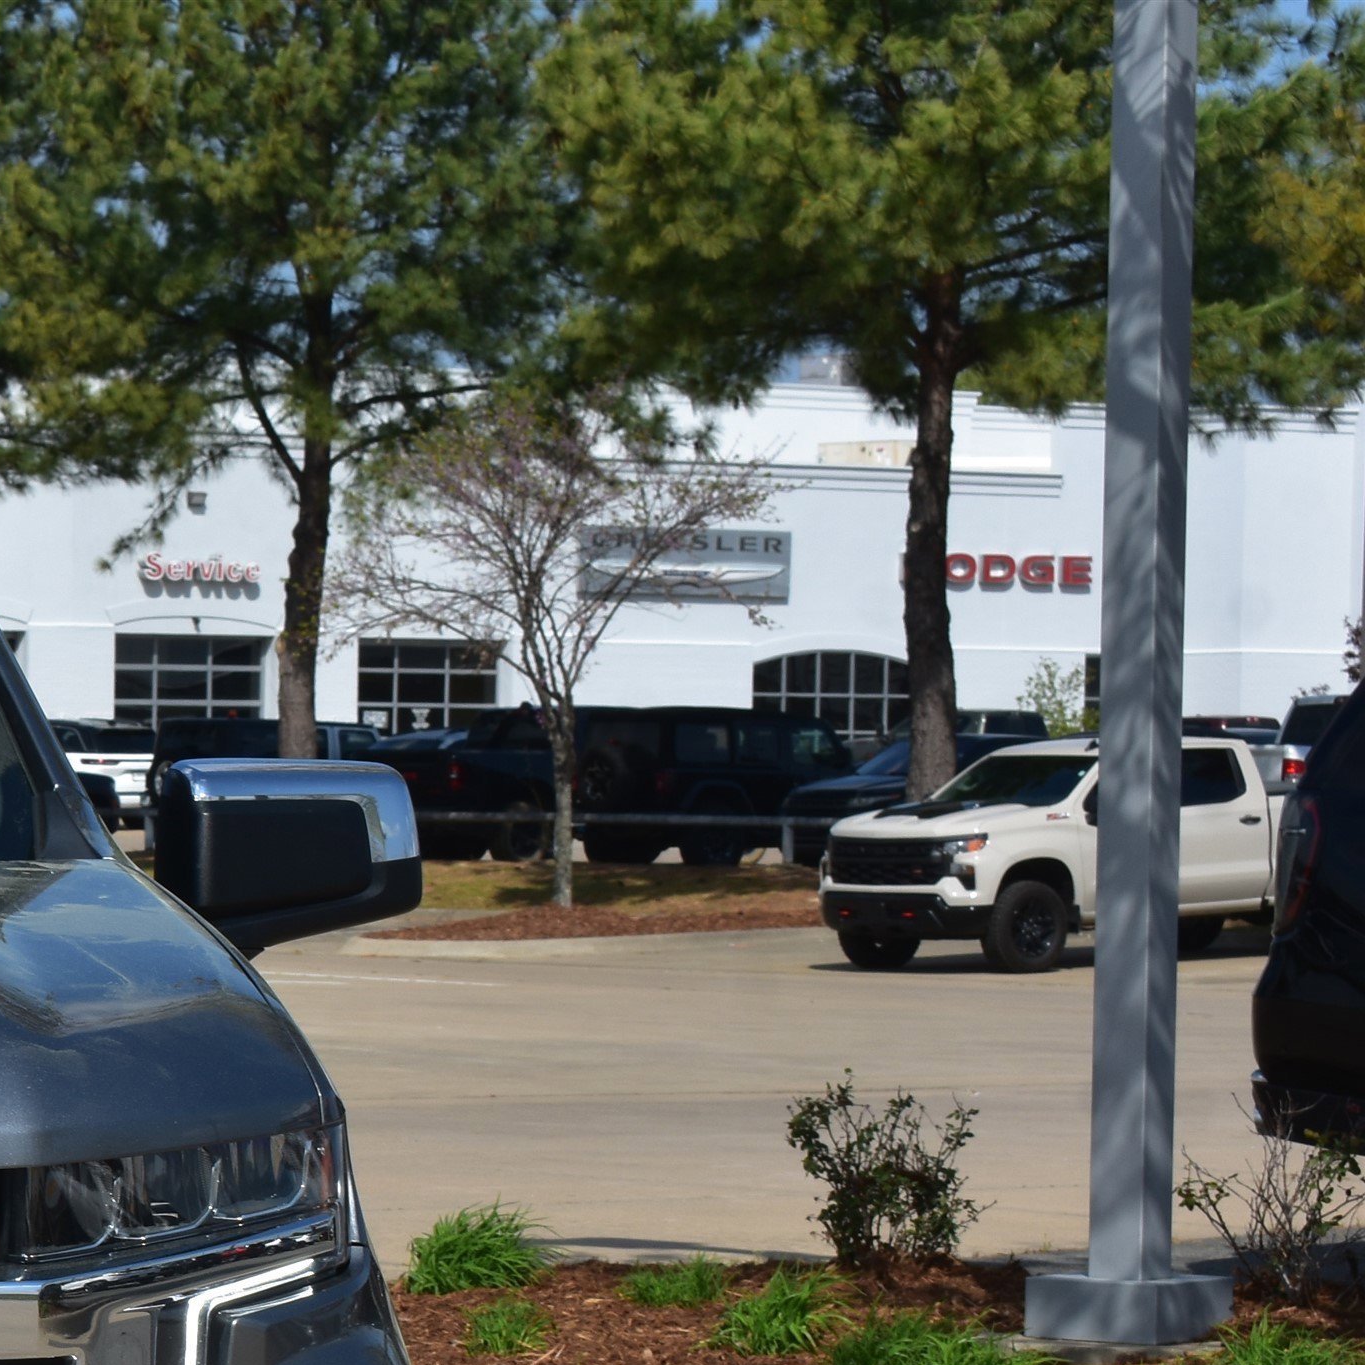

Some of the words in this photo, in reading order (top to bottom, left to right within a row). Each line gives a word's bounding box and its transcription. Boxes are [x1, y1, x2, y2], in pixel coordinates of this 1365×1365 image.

[591, 533, 782, 553] CHSLER
[145, 553, 261, 583] Service
[891, 553, 1093, 585] ODGE
